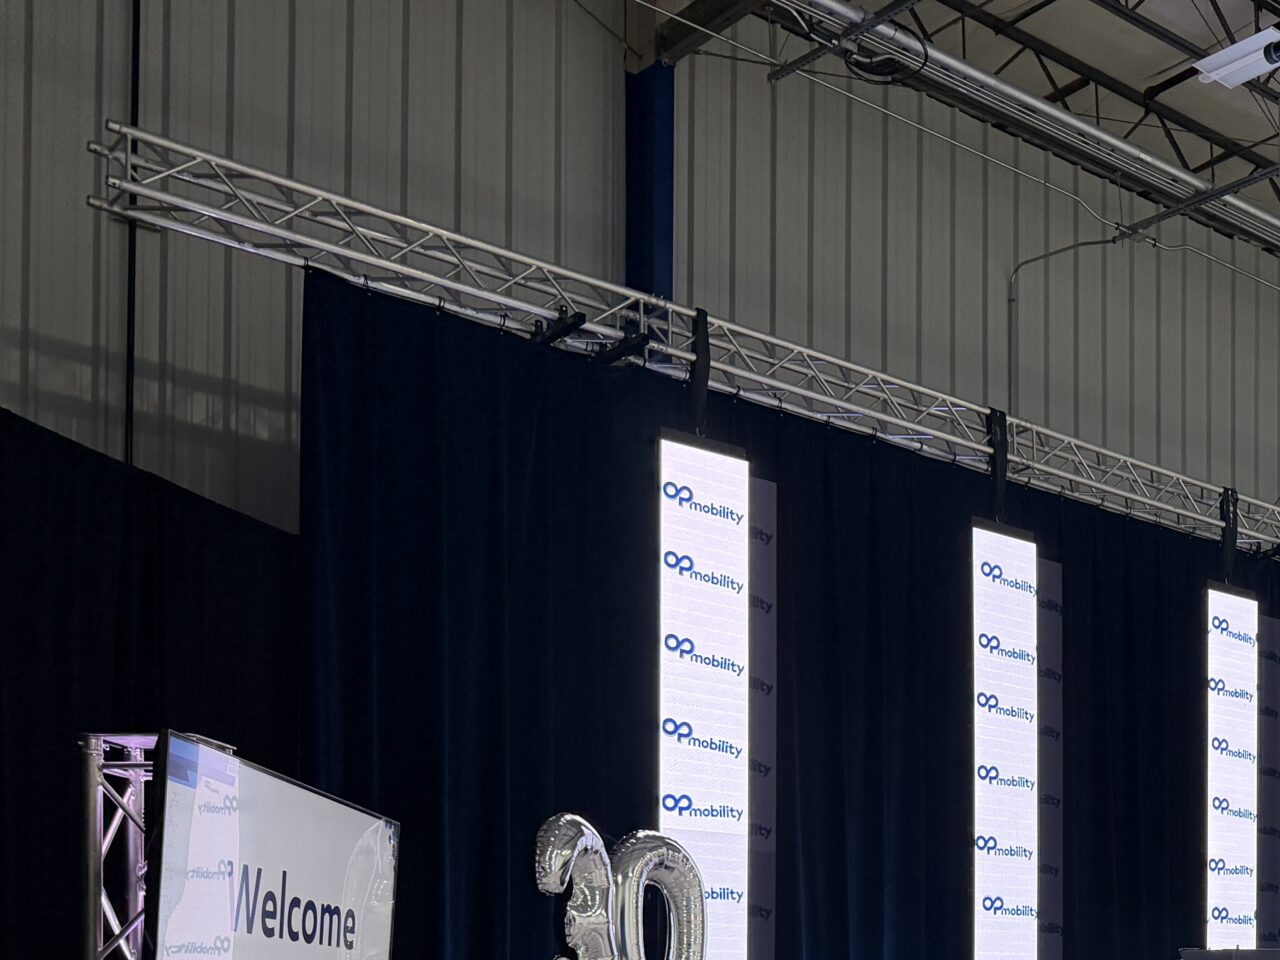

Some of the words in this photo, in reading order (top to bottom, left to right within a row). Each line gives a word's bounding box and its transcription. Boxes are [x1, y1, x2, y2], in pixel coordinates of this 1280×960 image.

[663, 481, 744, 525] OPmobility
[664, 551, 744, 594] OPmobility
[981, 561, 1037, 597] OPmobility
[664, 633, 745, 676] OPmobility
[978, 633, 1036, 665] OPmobility
[977, 692, 1035, 723] OPmobility
[662, 718, 743, 759] OPmobility
[977, 765, 1036, 792] OPmobility
[662, 794, 744, 821] OPmobility
[975, 835, 1034, 861] OPmobility
[228, 859, 356, 950] Welcome
[705, 888, 744, 903] obility
[982, 896, 1039, 919] OPmobility
